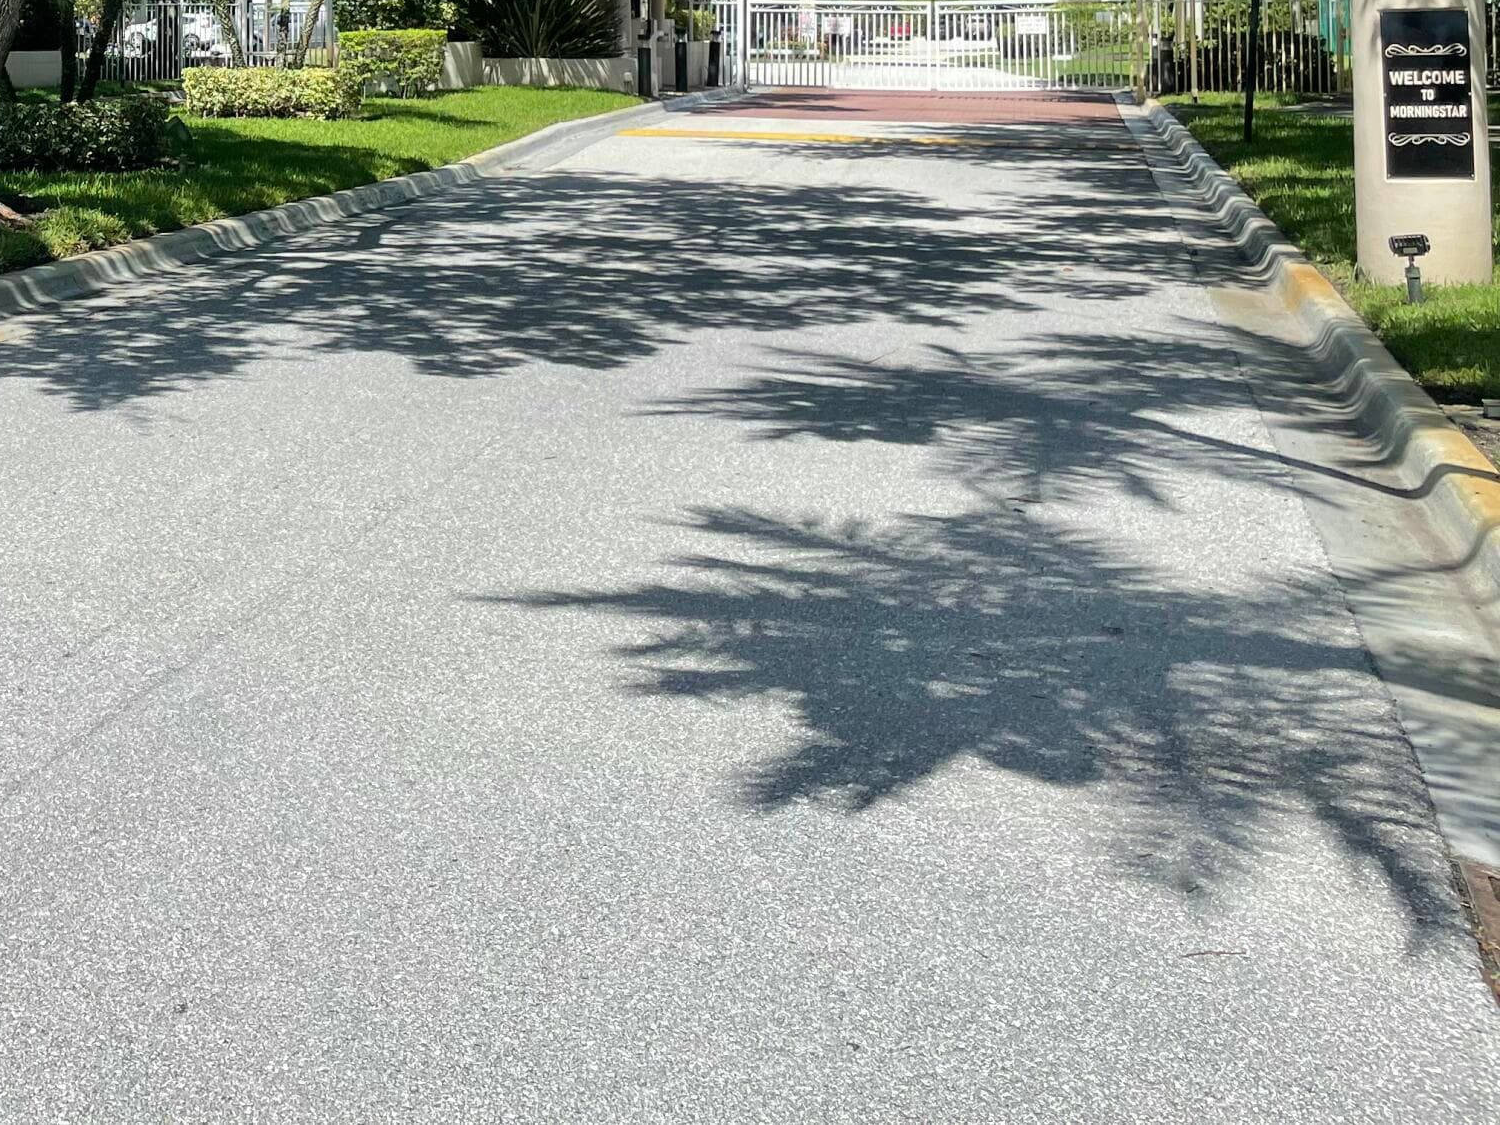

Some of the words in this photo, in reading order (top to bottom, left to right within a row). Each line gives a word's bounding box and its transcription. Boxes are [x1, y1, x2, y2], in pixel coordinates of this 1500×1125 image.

[1388, 70, 1466, 86] WELCOME
[1420, 88, 1435, 101] TO
[1389, 104, 1468, 118] MORNINGSTAR
